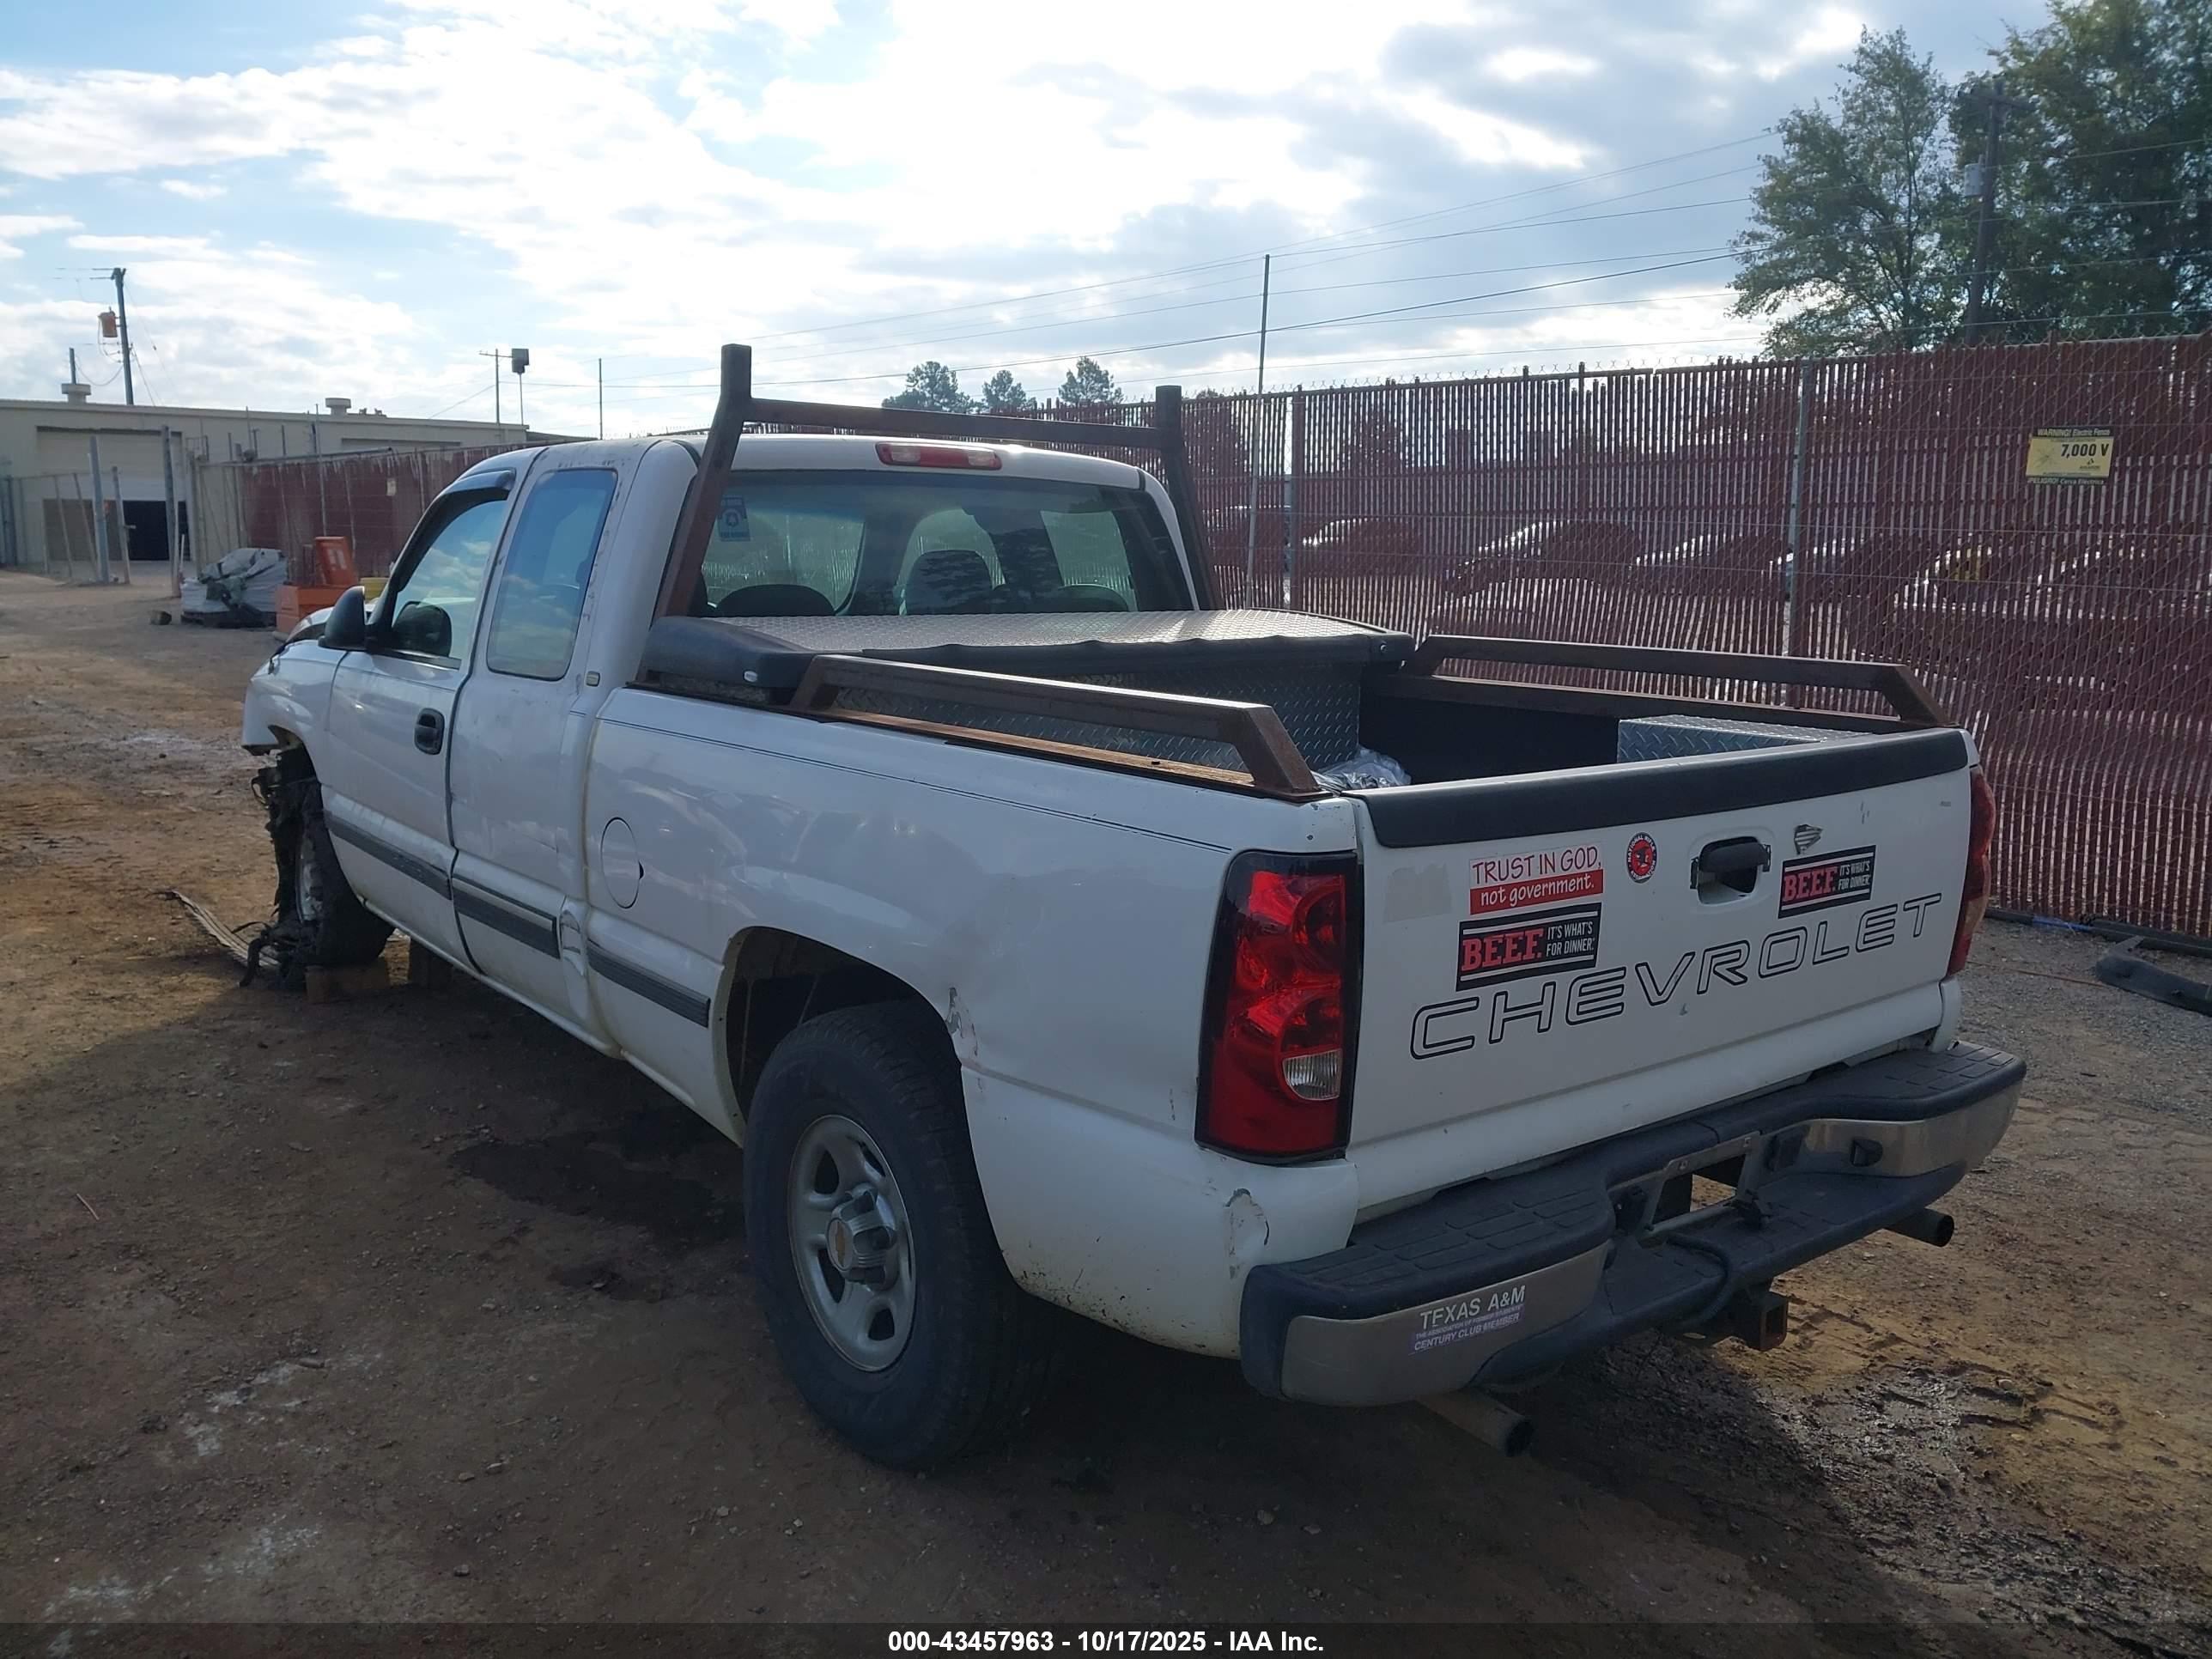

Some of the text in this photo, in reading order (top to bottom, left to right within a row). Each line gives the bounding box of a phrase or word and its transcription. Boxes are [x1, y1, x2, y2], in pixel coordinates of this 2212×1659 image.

[2061, 443, 2109, 459] 7,000 V
[1472, 854, 1535, 884] TRUST
[1539, 851, 1556, 875] IN
[1560, 846, 1601, 872] GOD,
[1480, 874, 1595, 908] not government.
[1838, 878, 1850, 890] FOR
[1547, 921, 1594, 940] IT'S WHAT'S
[1461, 927, 1544, 972] BEEF.
[1546, 942, 1562, 957] FOR
[1410, 892, 1942, 1060] CHEVROLET
[1487, 1285, 1526, 1312] A&M
[1414, 1312, 1520, 1351] CENTURY CLUB MEMBER
